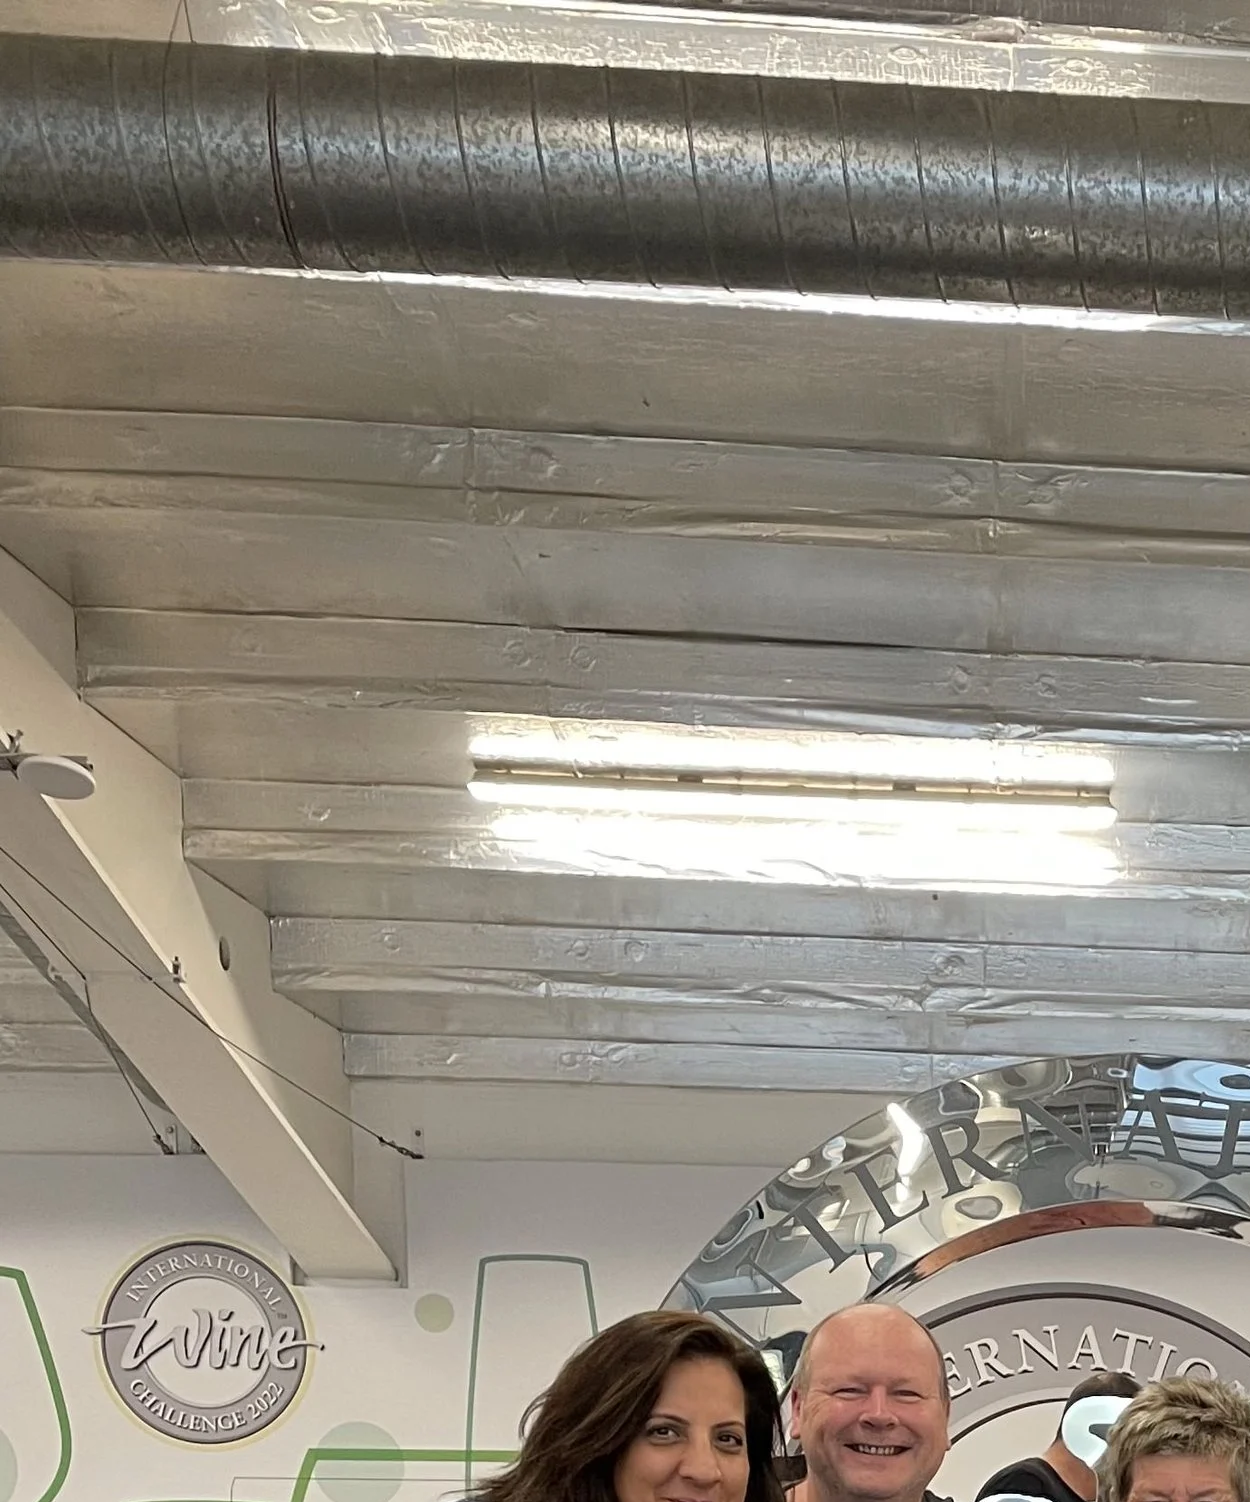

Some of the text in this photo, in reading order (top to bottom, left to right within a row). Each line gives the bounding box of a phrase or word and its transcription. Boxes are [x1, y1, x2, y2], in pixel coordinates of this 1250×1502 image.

[126, 1253, 283, 1312] INTERNATIONAL
[81, 1308, 326, 1370] Wine
[130, 1379, 285, 1433] CHALLENGE 2022
